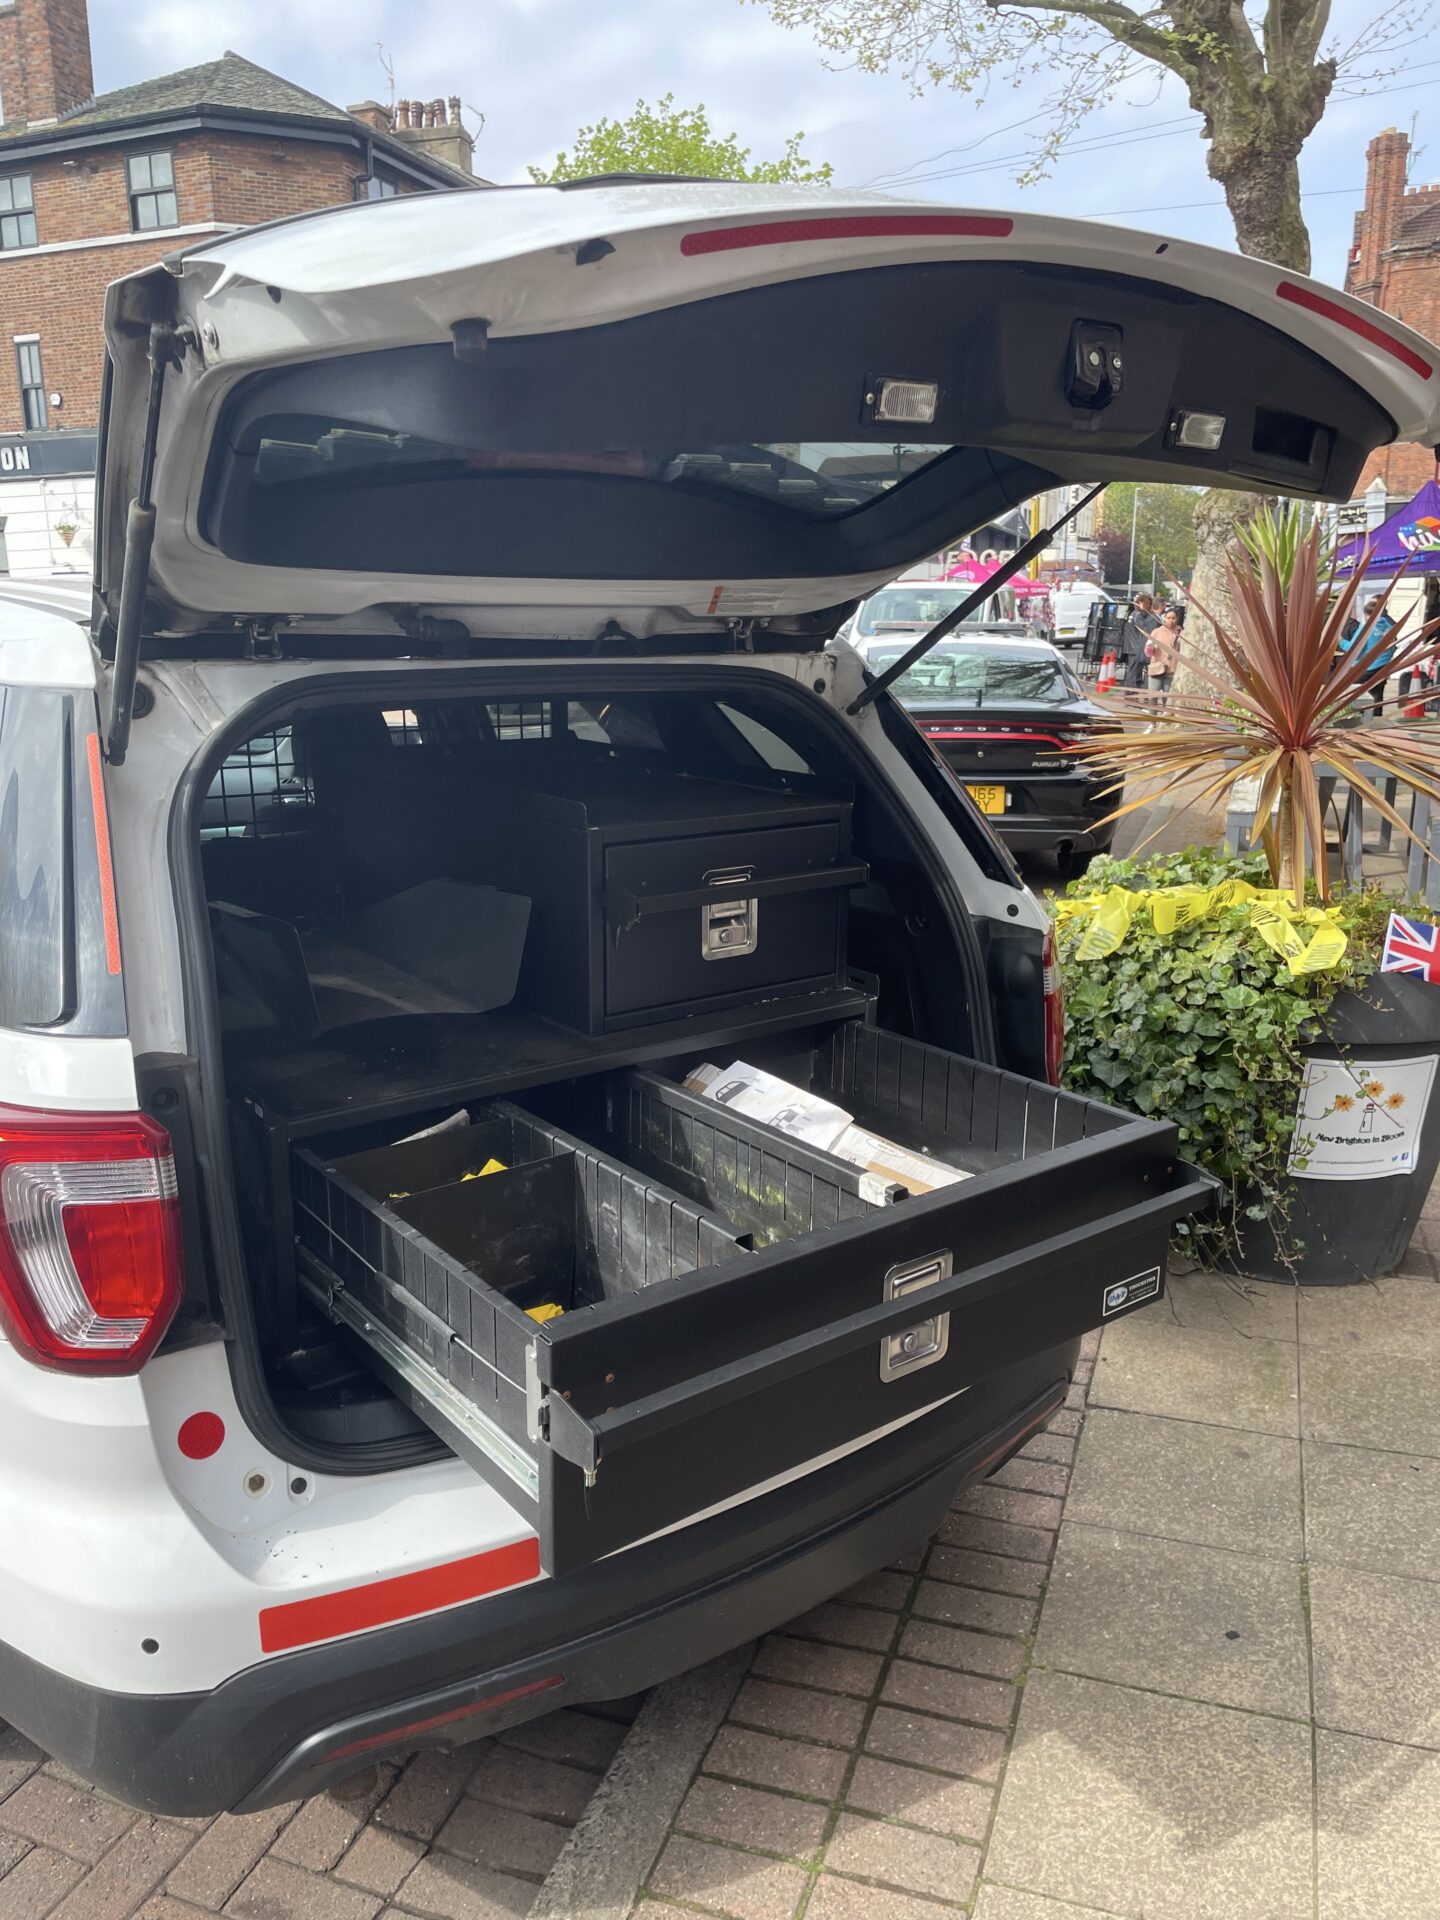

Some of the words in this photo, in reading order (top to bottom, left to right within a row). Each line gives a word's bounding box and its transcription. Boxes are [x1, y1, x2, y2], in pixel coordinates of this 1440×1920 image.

[0, 446, 31, 470] ON
[1316, 1133, 1334, 1142] New
[1335, 1137, 1371, 1145] Brighton
[1381, 1131, 1405, 1142] Bloom
